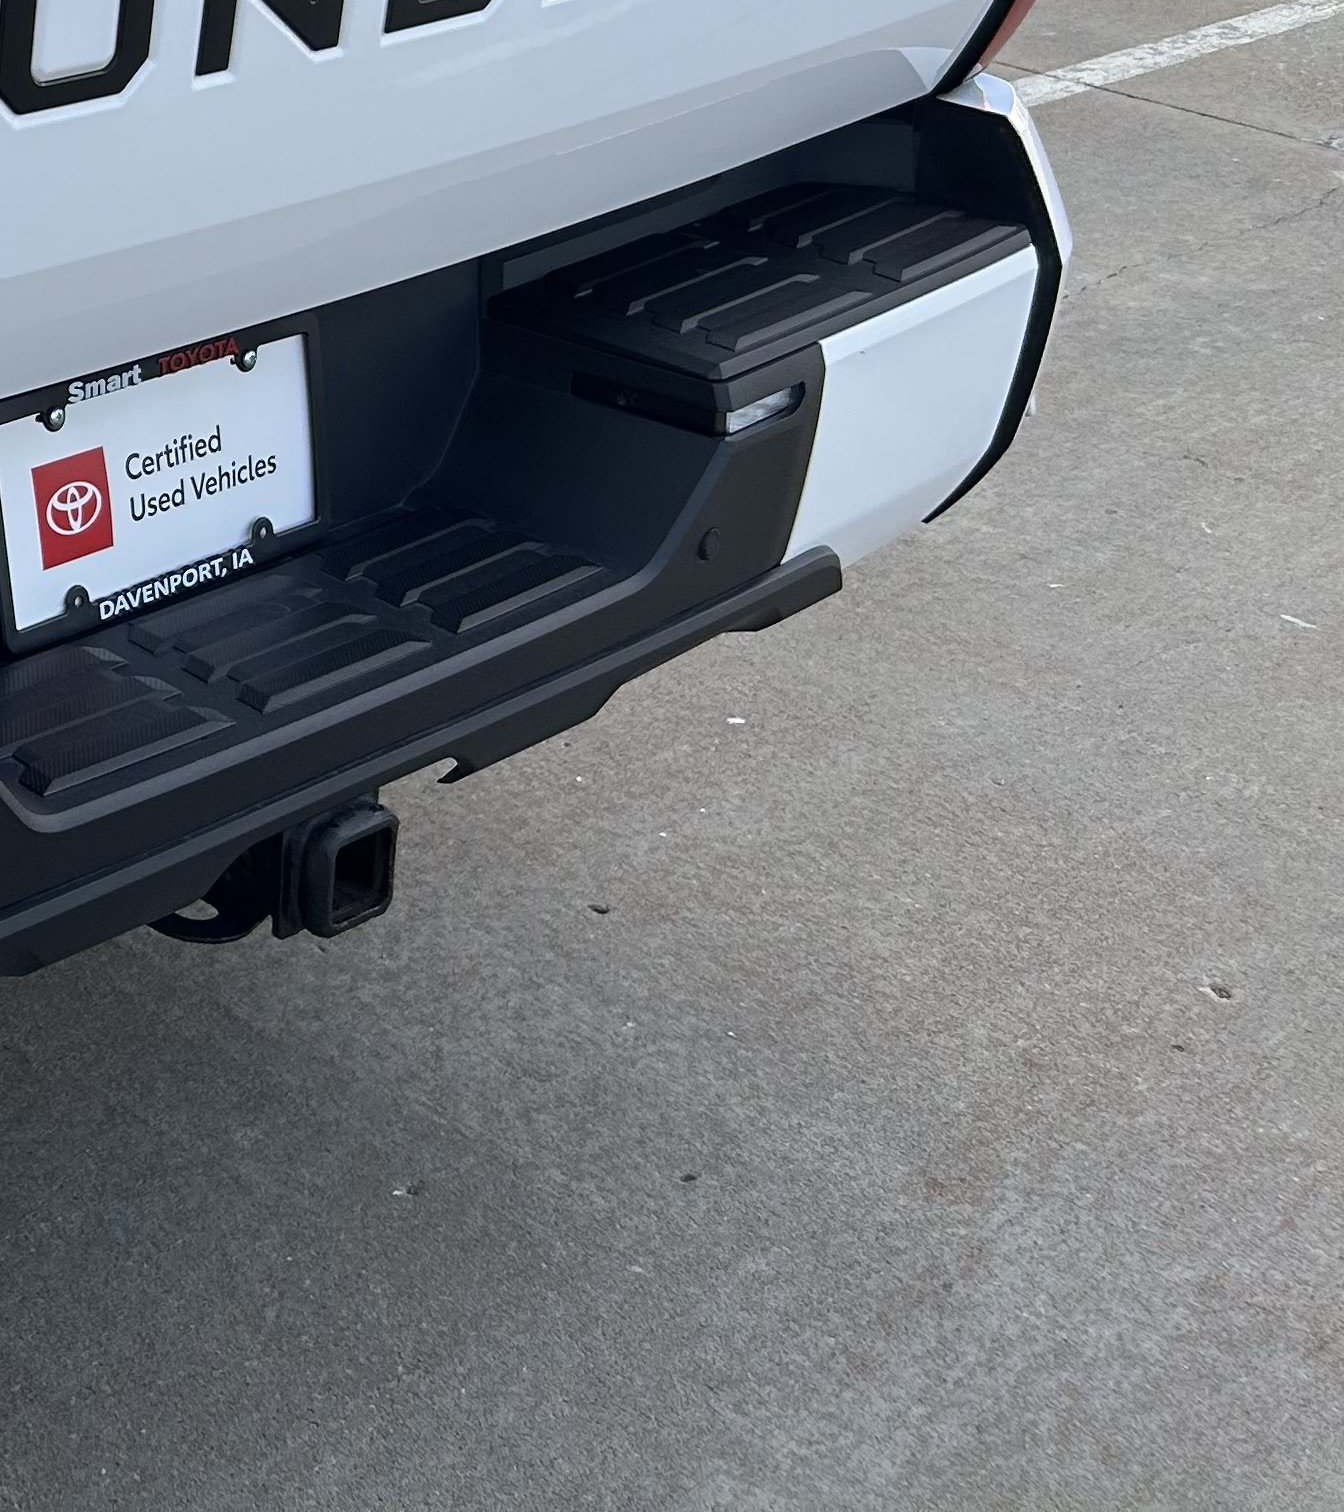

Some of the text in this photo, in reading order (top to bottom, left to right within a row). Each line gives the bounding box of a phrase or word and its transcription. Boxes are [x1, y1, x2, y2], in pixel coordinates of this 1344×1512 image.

[67, 336, 240, 404] Smart TOYOTA
[124, 424, 223, 480] Certified
[129, 454, 278, 522] Used Vehicles
[99, 548, 255, 621] DAVENPORT, IA
